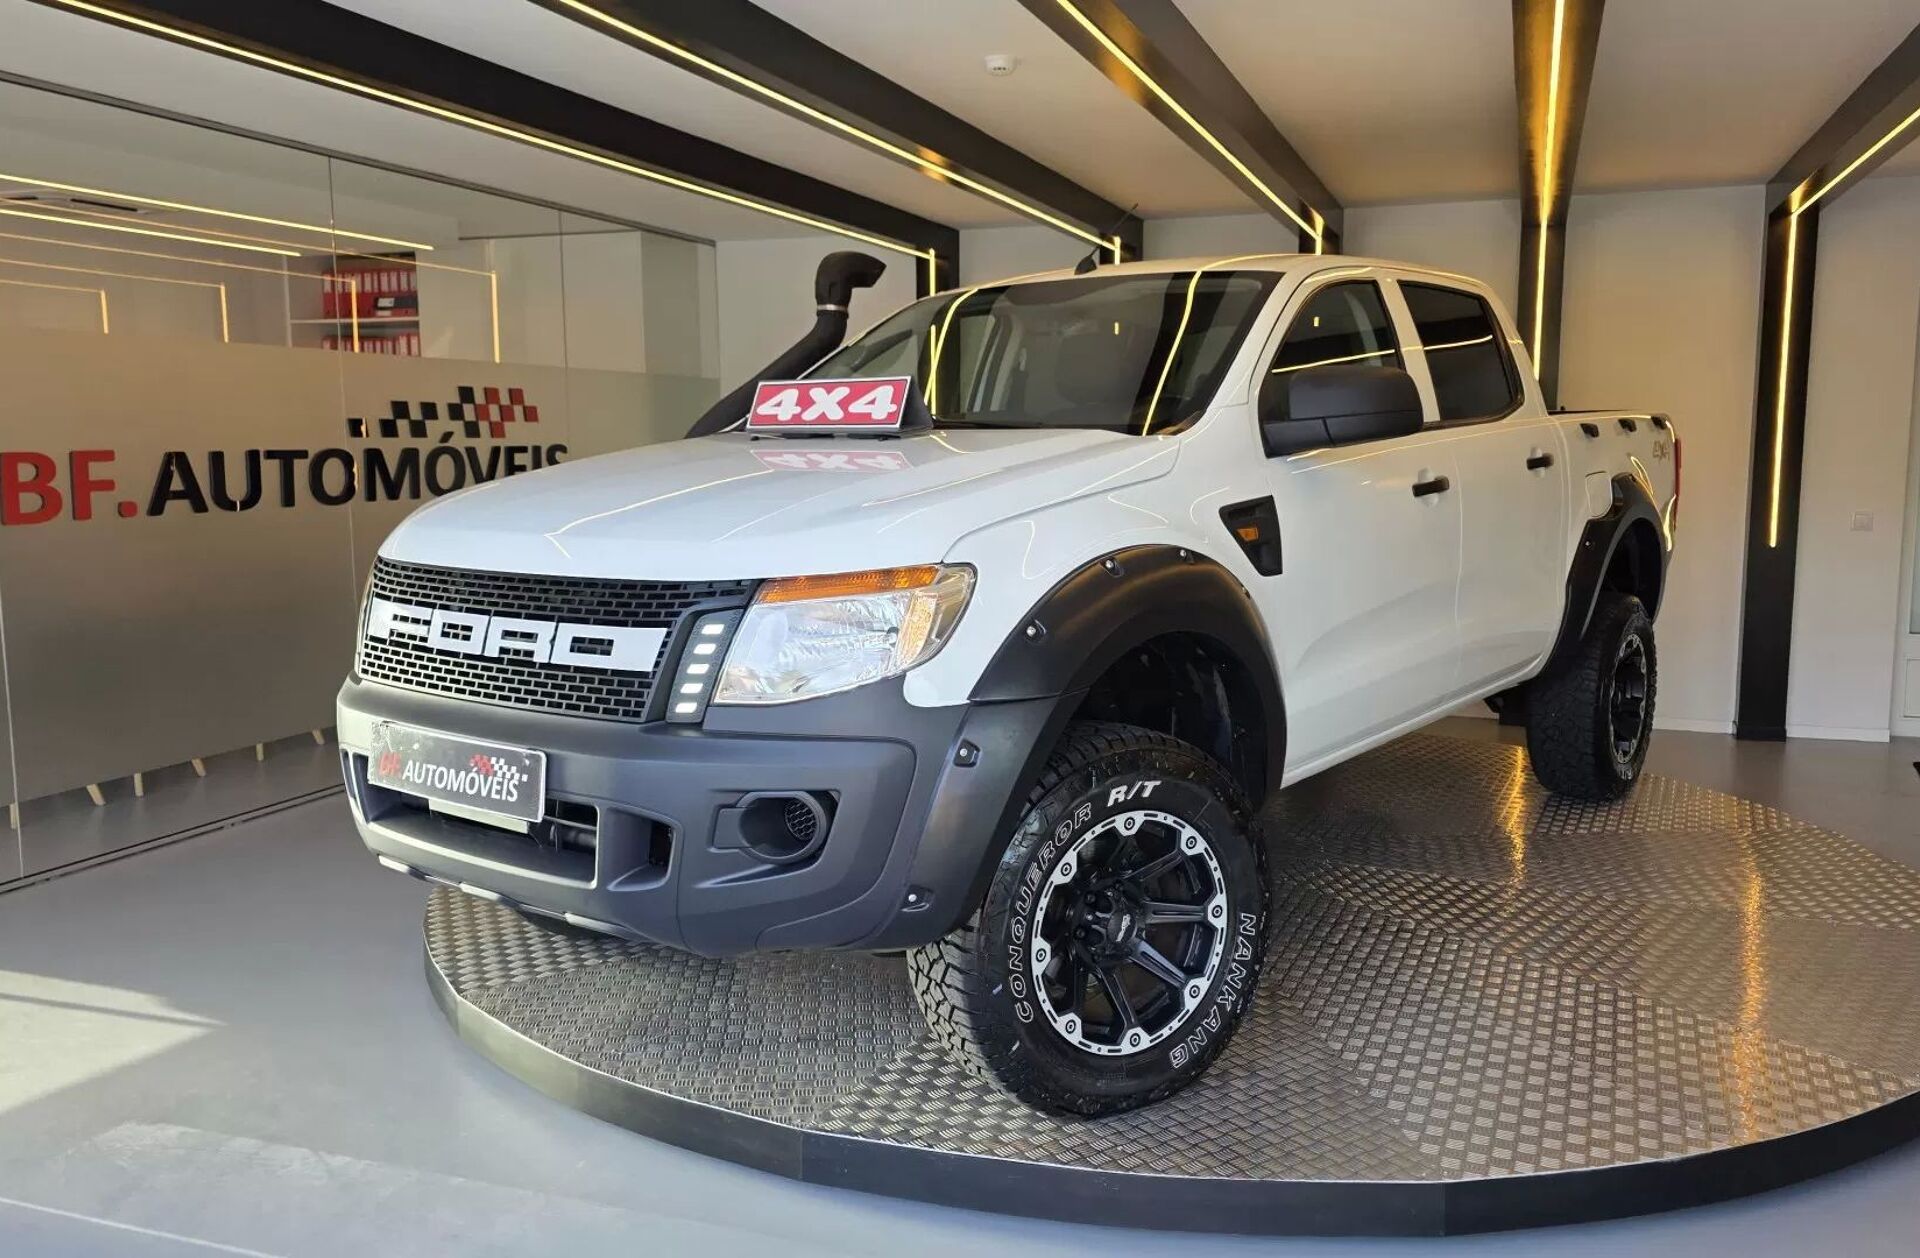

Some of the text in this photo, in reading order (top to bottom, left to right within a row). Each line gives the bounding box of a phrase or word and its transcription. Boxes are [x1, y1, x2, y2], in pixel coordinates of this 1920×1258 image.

[756, 385, 898, 421] 4X4
[367, 596, 668, 671] FORD
[402, 759, 518, 801] AUTOMÓVEIS
[1010, 780, 1162, 1024] CONQUEROR R/T
[1169, 912, 1257, 1069] NANKANG
